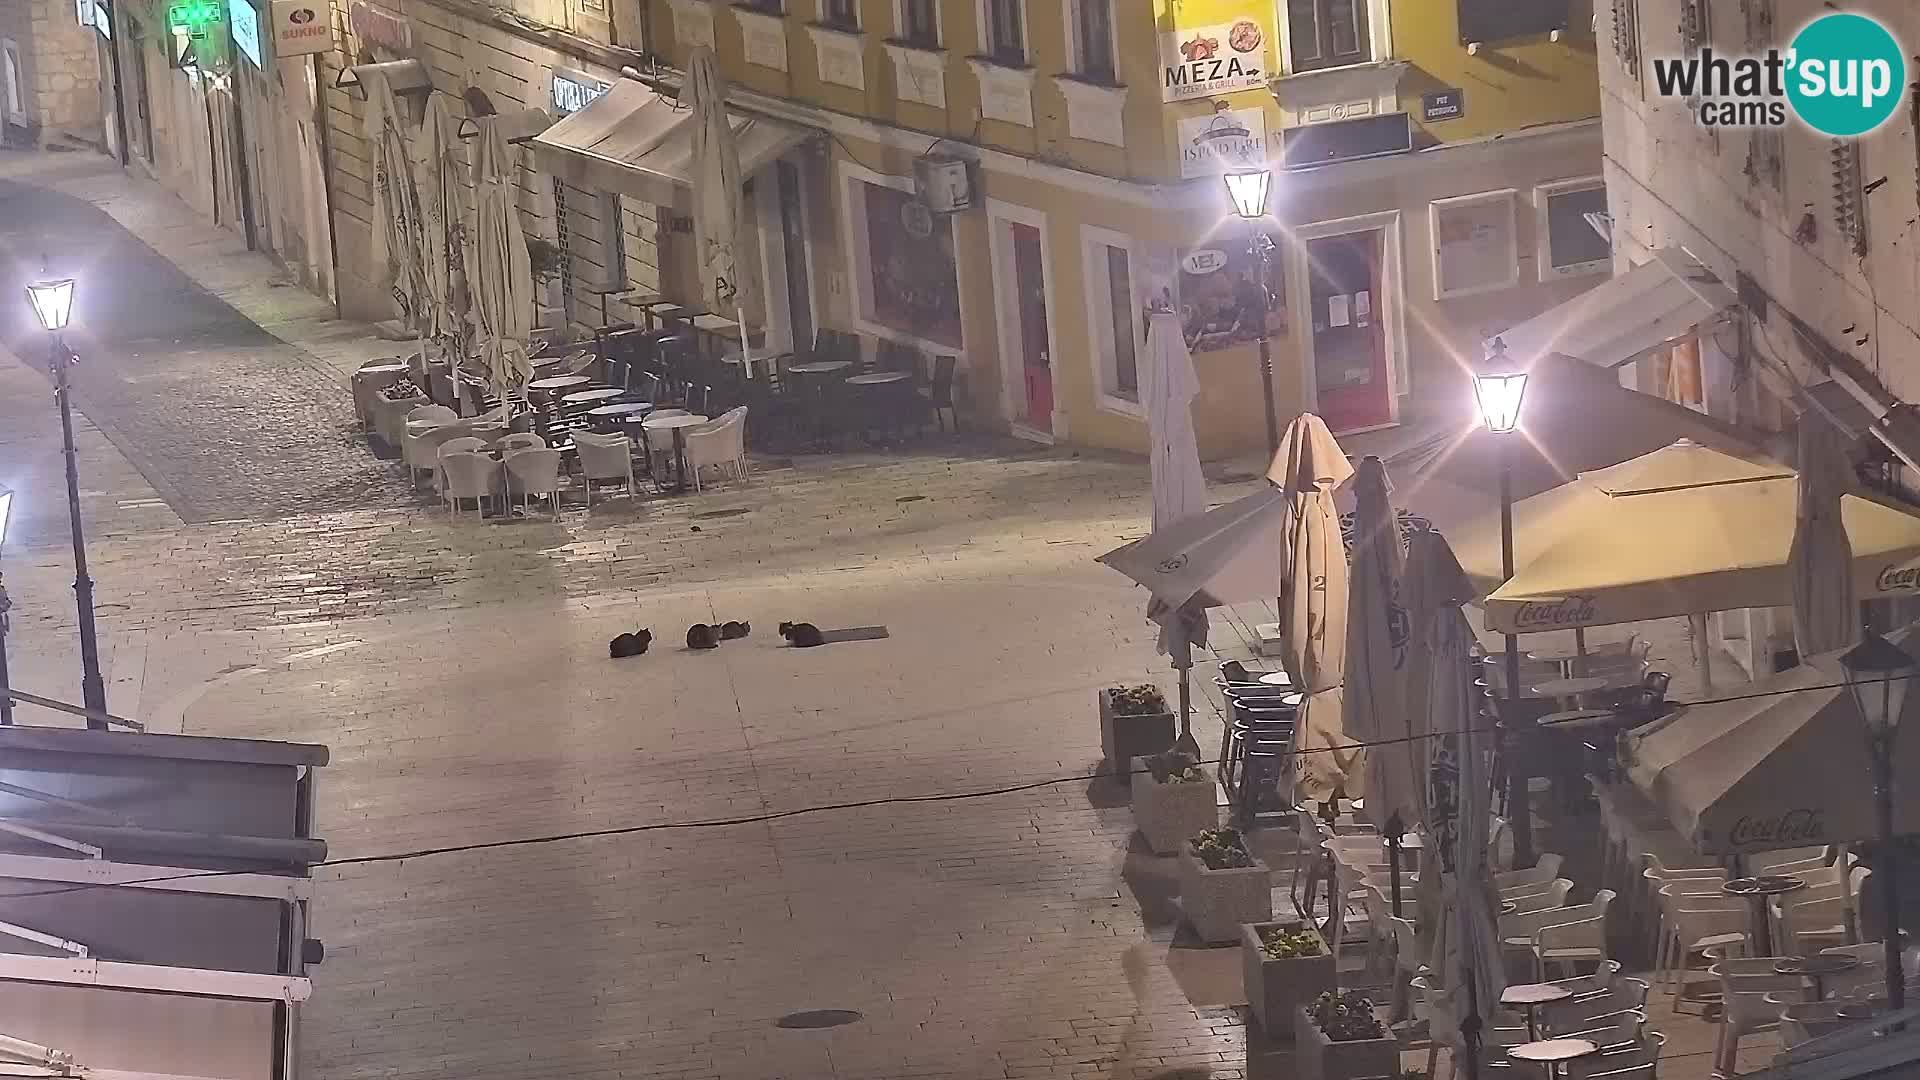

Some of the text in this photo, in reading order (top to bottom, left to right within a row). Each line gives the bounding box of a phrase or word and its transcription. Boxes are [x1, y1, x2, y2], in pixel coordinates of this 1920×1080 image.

[281, 26, 326, 39] SUKNO
[1165, 57, 1244, 87] MEZA
[1174, 83, 1207, 97] PIZZERIA
[1215, 78, 1236, 90] GRILL
